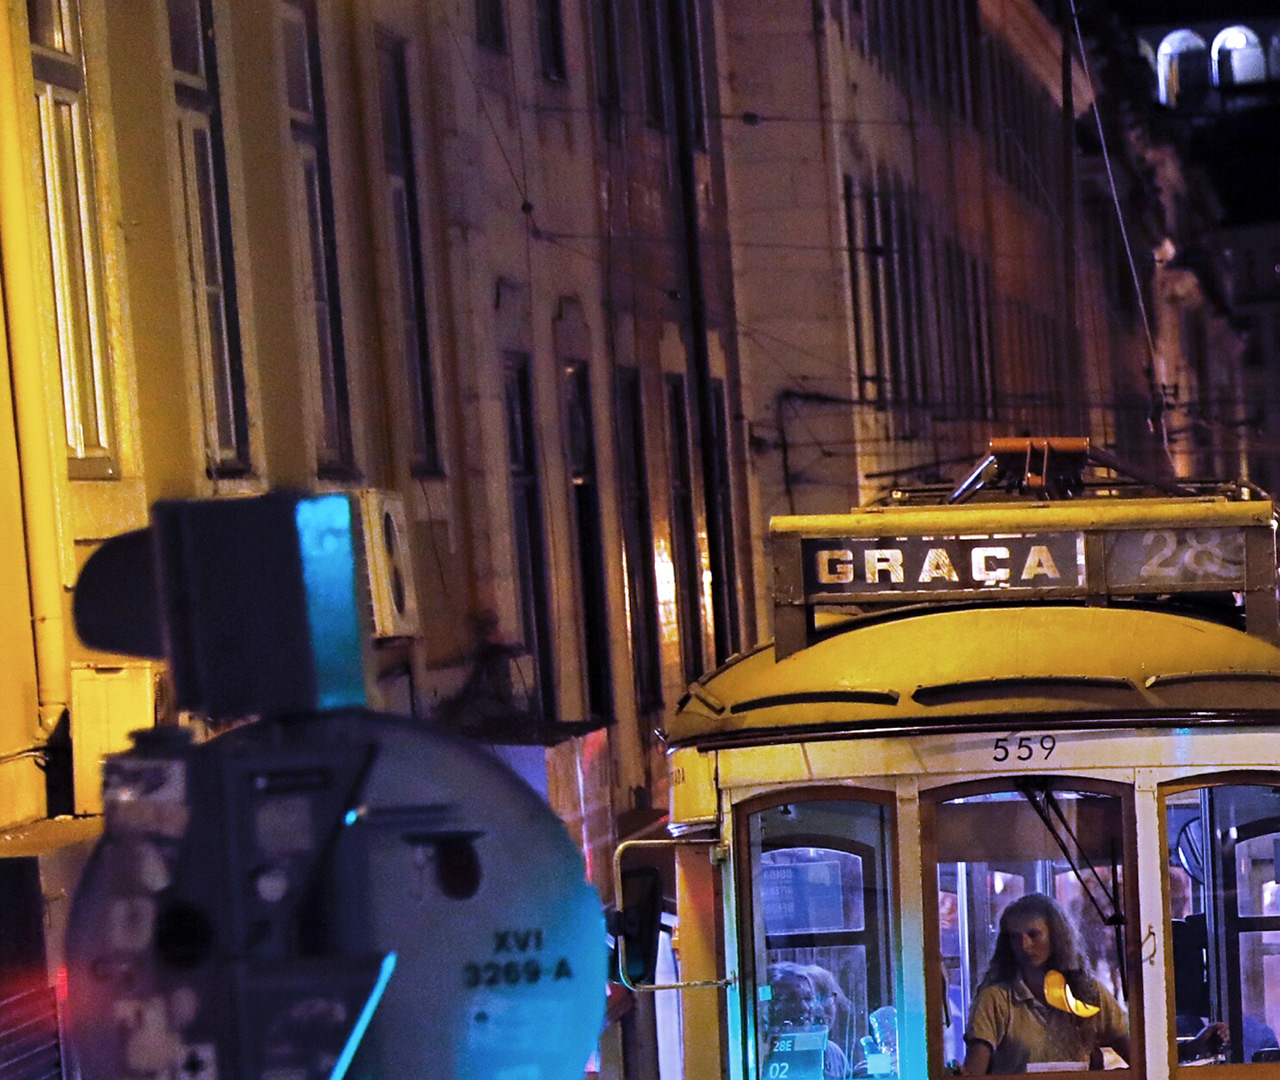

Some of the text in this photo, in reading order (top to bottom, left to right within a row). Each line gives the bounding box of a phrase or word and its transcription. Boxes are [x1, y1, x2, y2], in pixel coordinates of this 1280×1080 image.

[816, 529, 1223, 588] GRAÇA 28
[993, 734, 1056, 761] 559
[493, 929, 543, 954] XVI
[463, 957, 573, 989] 3269-A
[773, 1040, 793, 1051] 28E
[769, 1062, 789, 1078] 02
